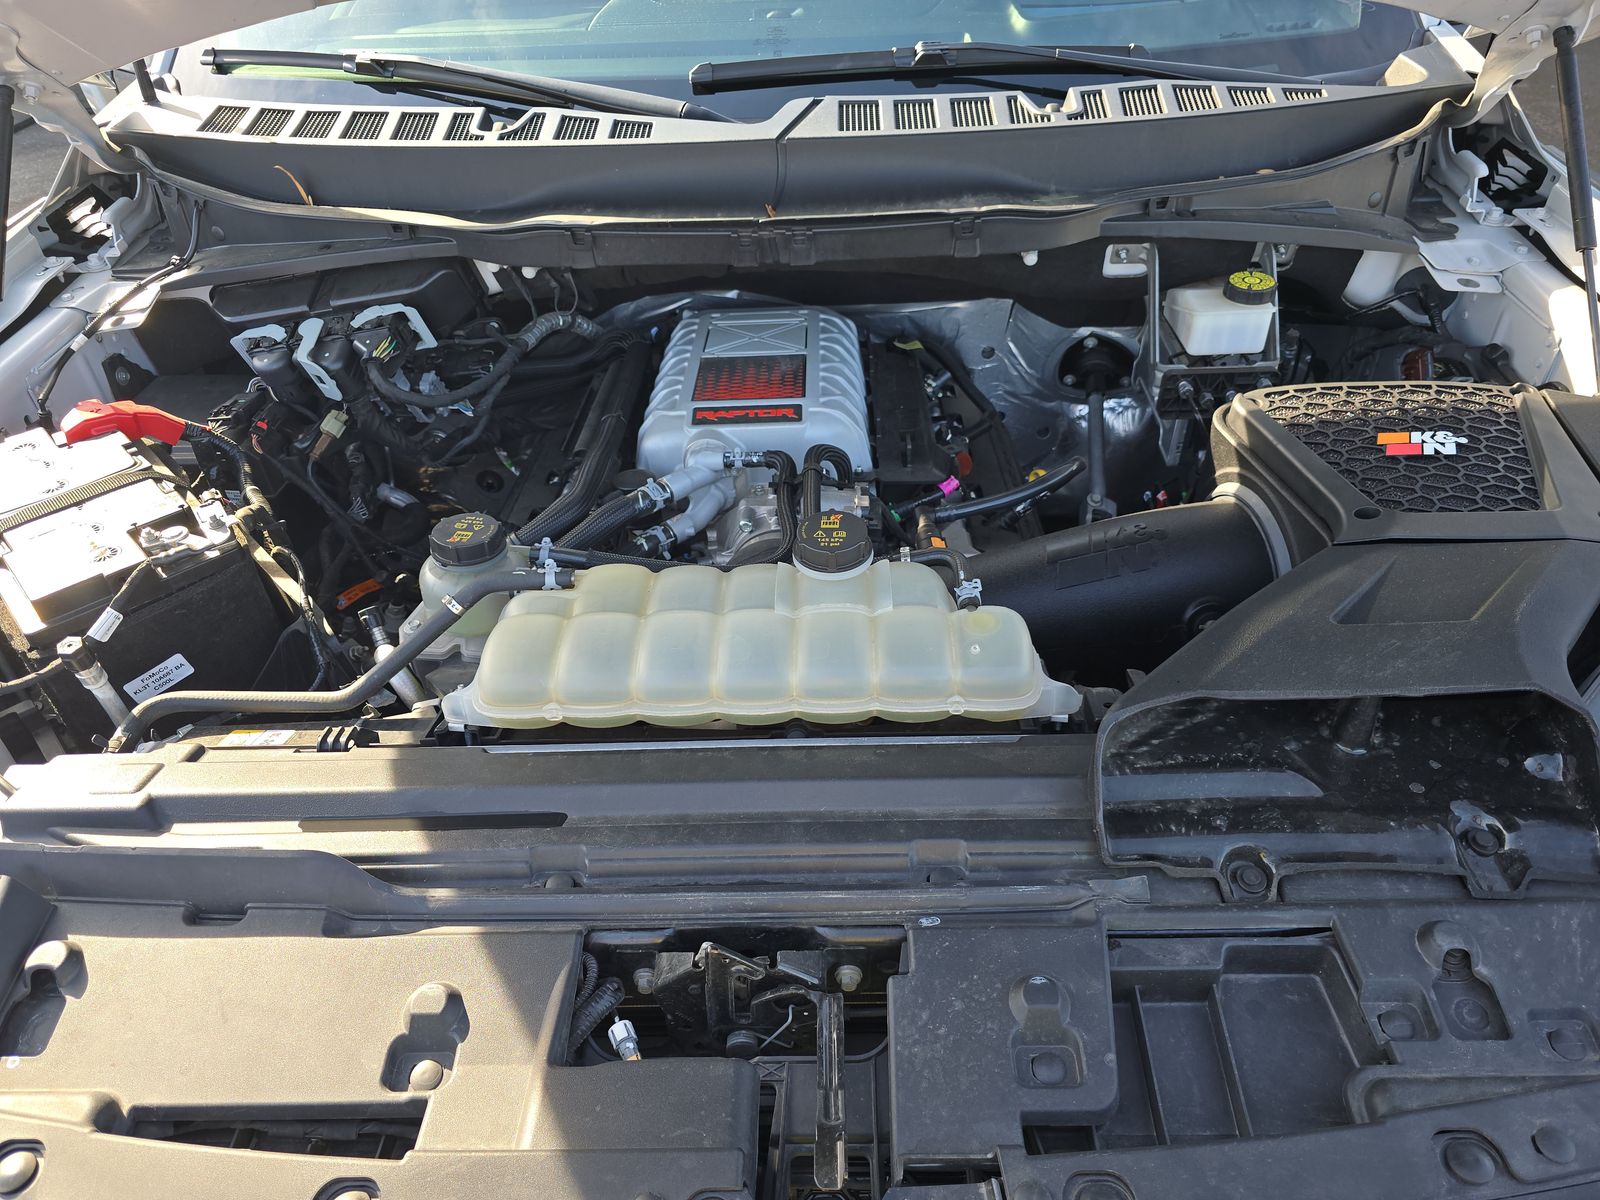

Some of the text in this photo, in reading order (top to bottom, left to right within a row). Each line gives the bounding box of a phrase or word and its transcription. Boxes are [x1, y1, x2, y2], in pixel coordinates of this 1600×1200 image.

[696, 408, 798, 421] RAPTOR
[133, 683, 151, 696] KL3T
[174, 662, 186, 671] BA
[140, 665, 169, 684] FoMoCo
[153, 677, 175, 691] C500L
